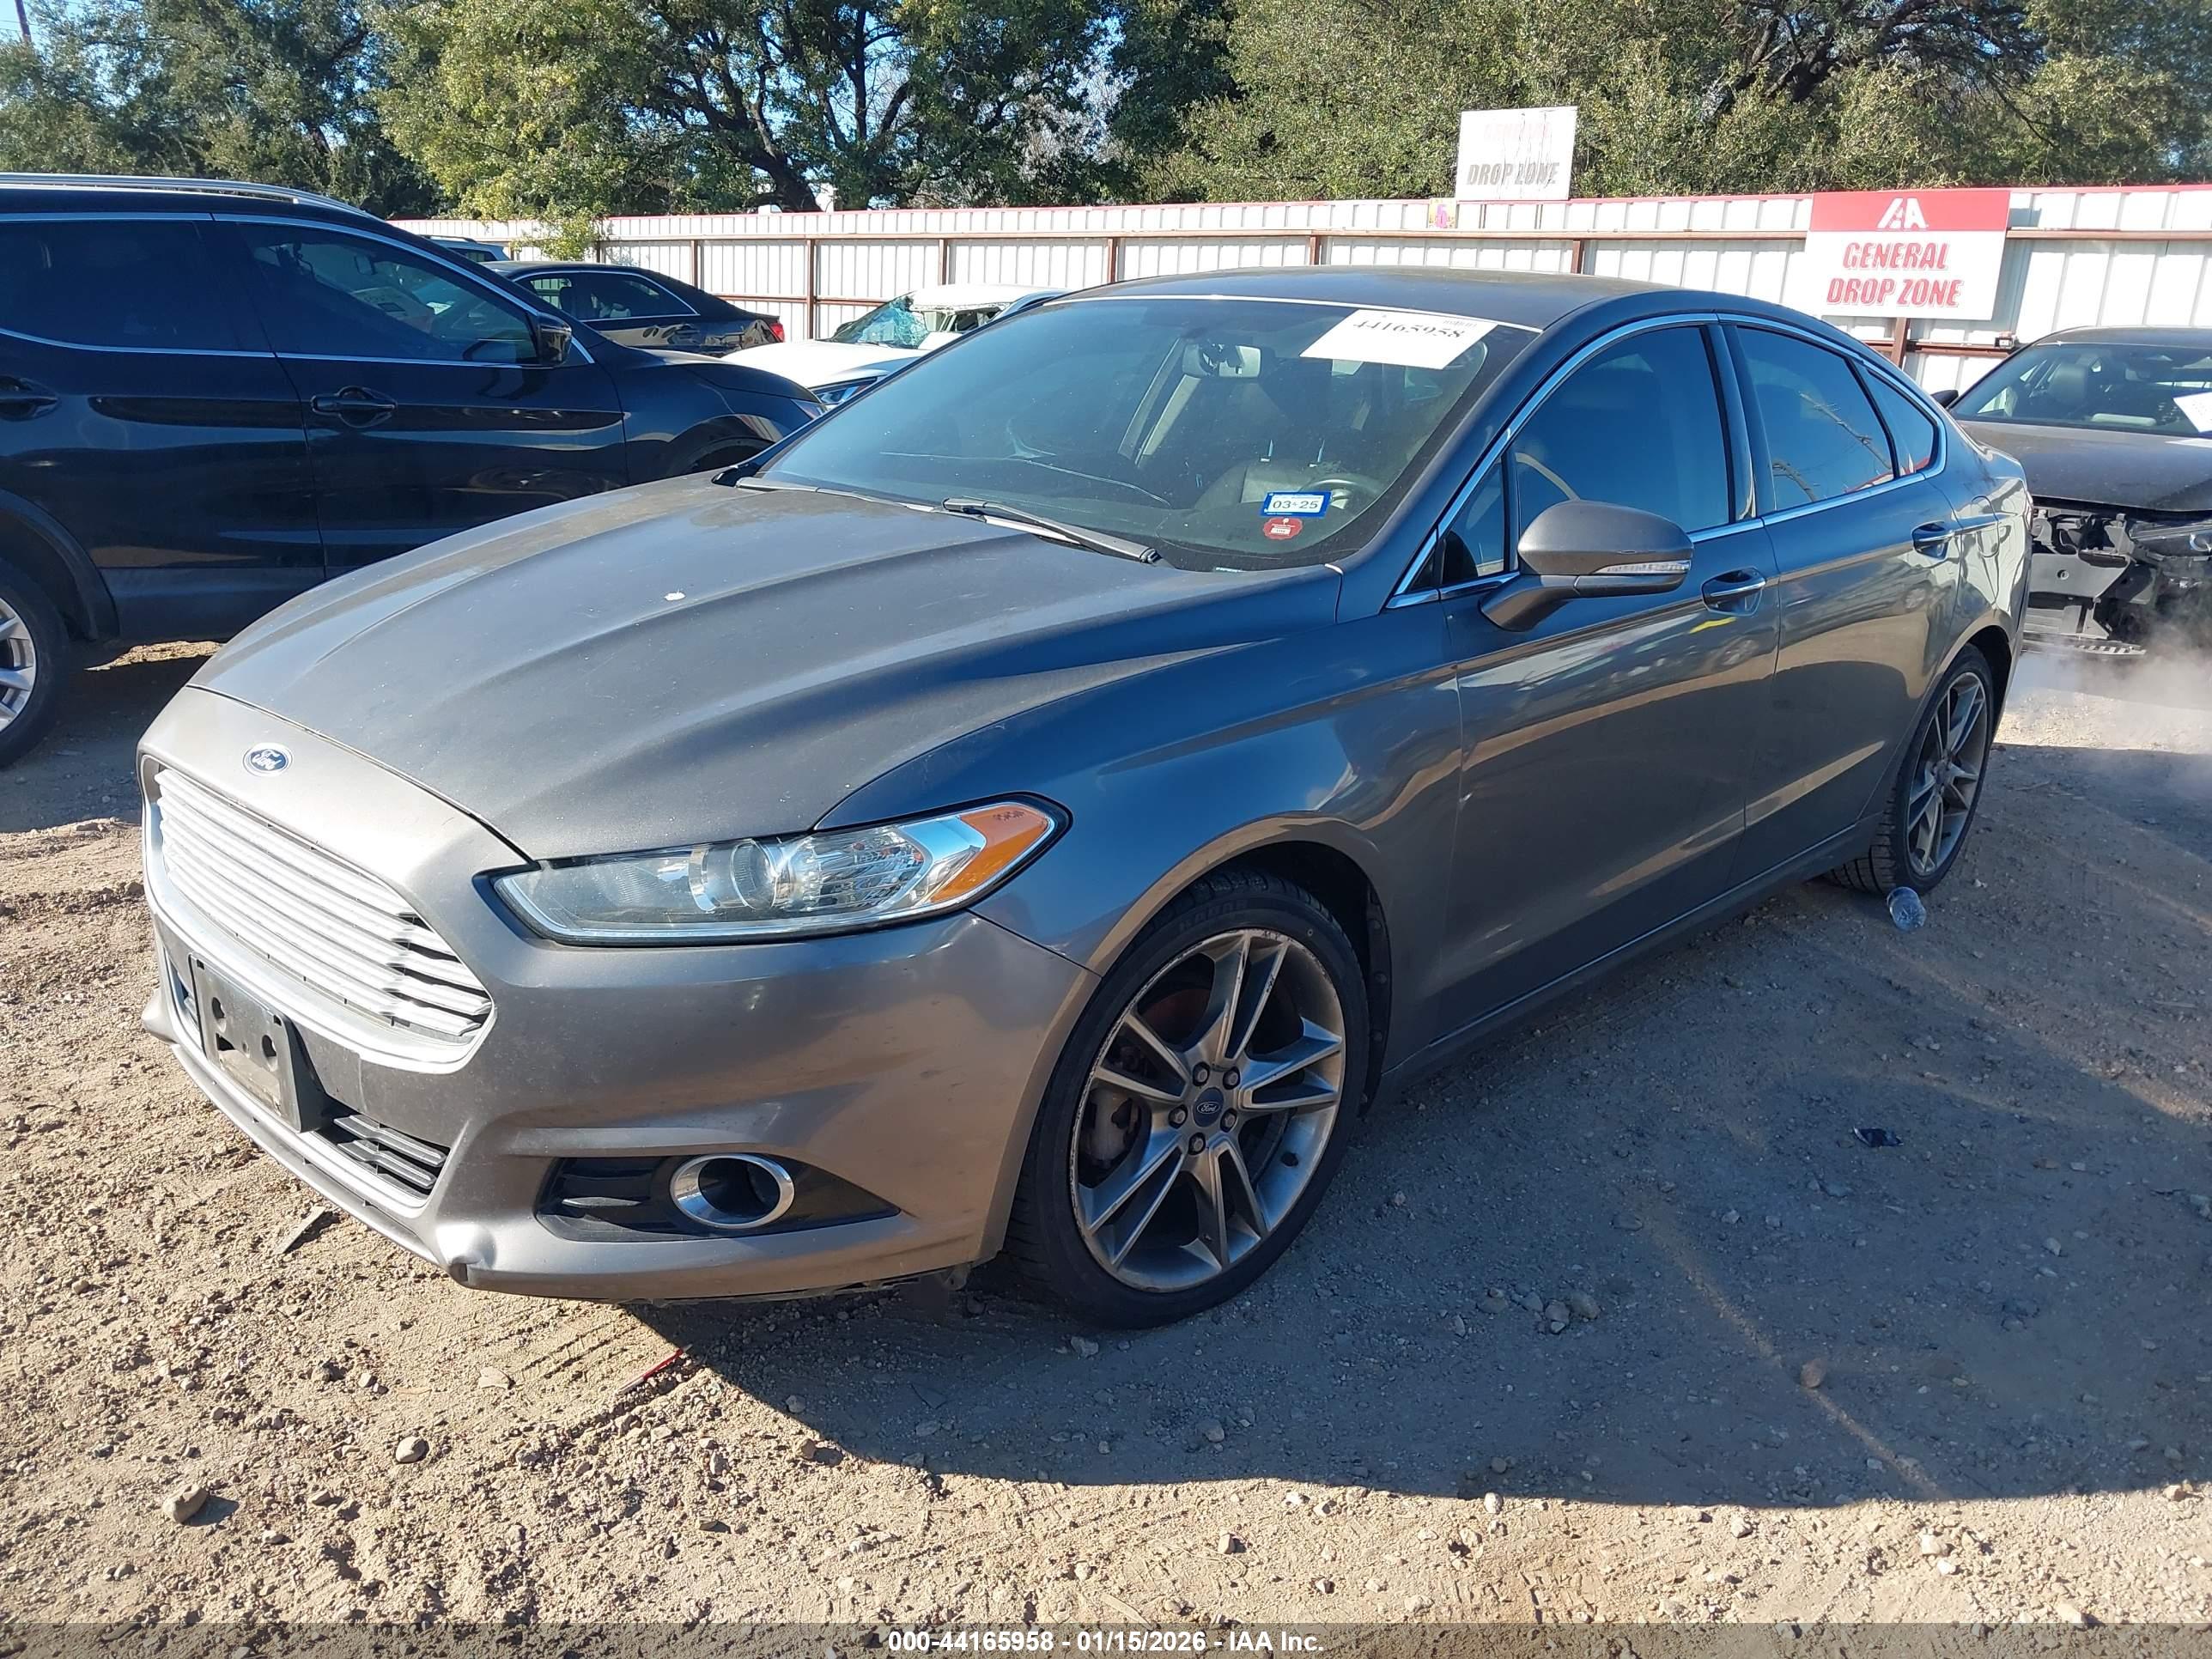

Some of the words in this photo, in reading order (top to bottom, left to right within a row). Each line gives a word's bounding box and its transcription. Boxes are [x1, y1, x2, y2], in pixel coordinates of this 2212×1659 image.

[1467, 162, 1514, 185] DROP
[1842, 241, 1950, 270] GENERAL
[1826, 276, 1896, 305] DROP
[1896, 278, 1965, 307] ZONE
[252, 749, 283, 770] Ford
